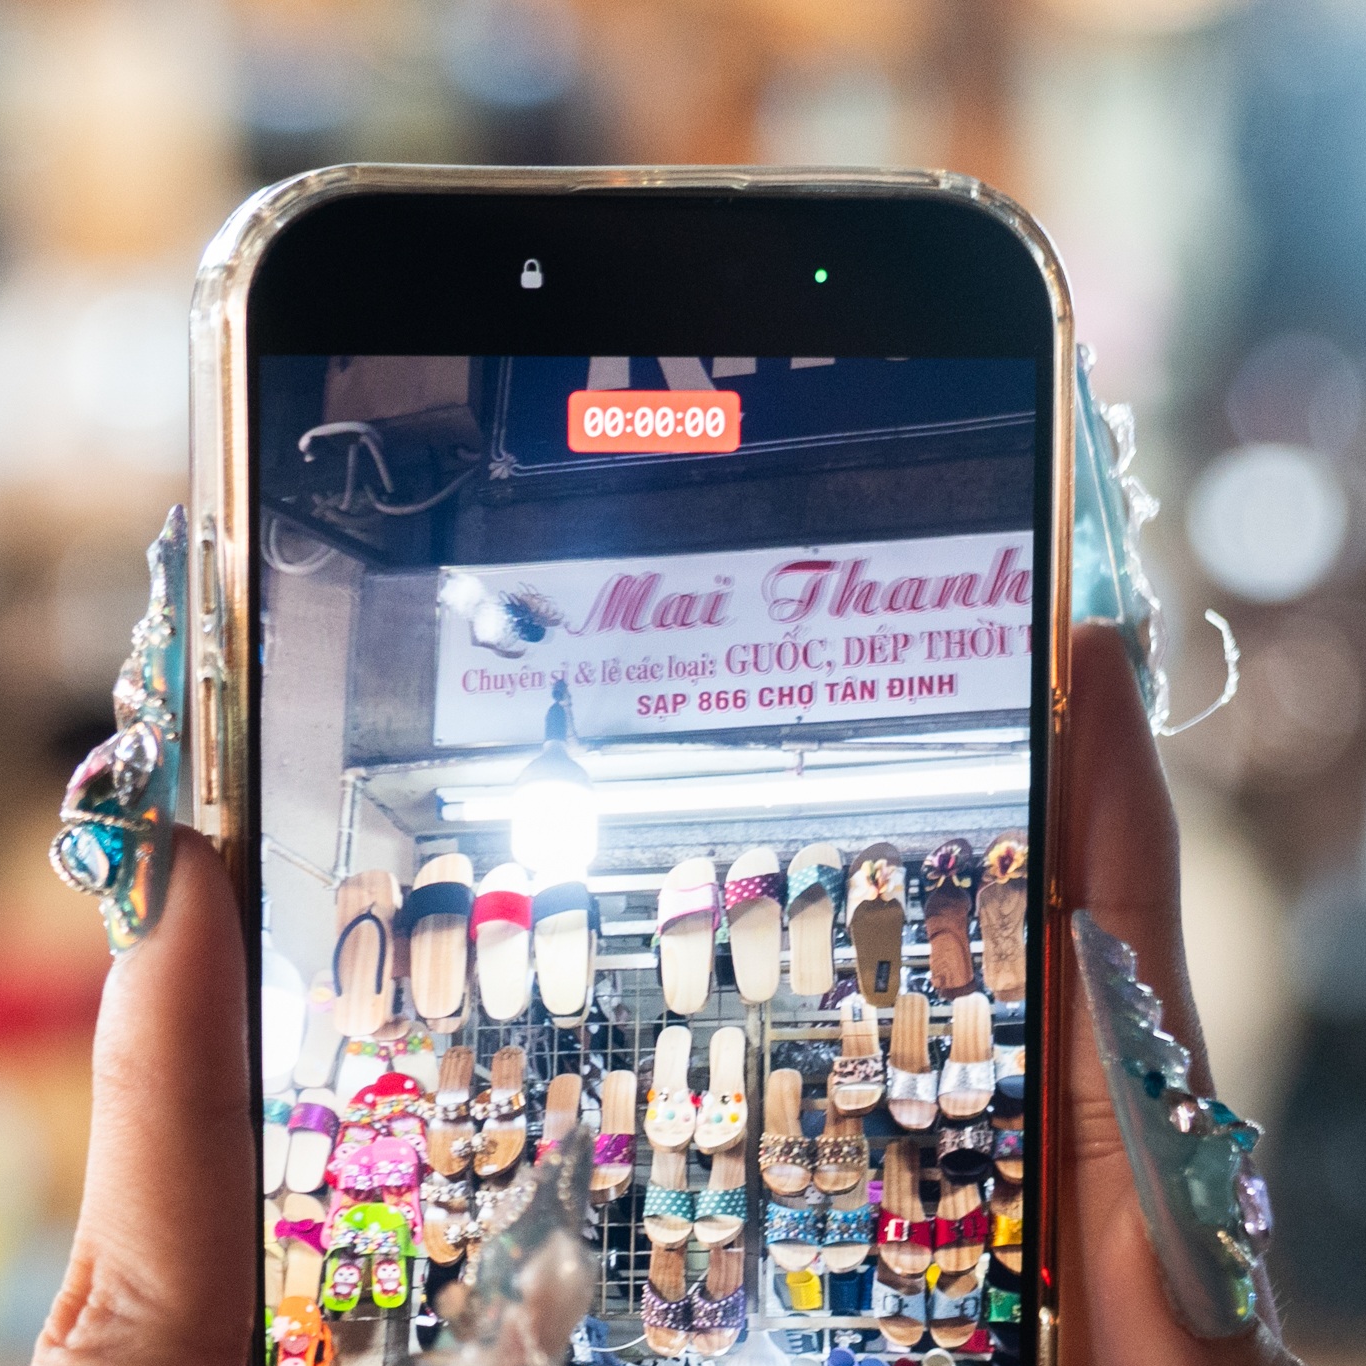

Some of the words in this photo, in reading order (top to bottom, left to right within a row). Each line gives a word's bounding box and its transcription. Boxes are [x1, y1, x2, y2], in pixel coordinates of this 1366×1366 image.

[583, 406, 726, 438] 00:00:00
[564, 571, 736, 636] Mai
[761, 546, 1032, 624] Thanh
[461, 666, 544, 696] Chuyên
[574, 661, 596, 687] &
[625, 656, 664, 682] các
[667, 653, 717, 686] loại:
[725, 625, 836, 677] GUỐC,
[842, 624, 915, 668] DÉP
[920, 617, 1014, 662] THỜI
[637, 693, 690, 721] SẠP
[698, 688, 748, 713] 866
[757, 681, 816, 711] CHỢ
[825, 676, 878, 704] TÂN
[886, 673, 958, 704] ĐỊNH
